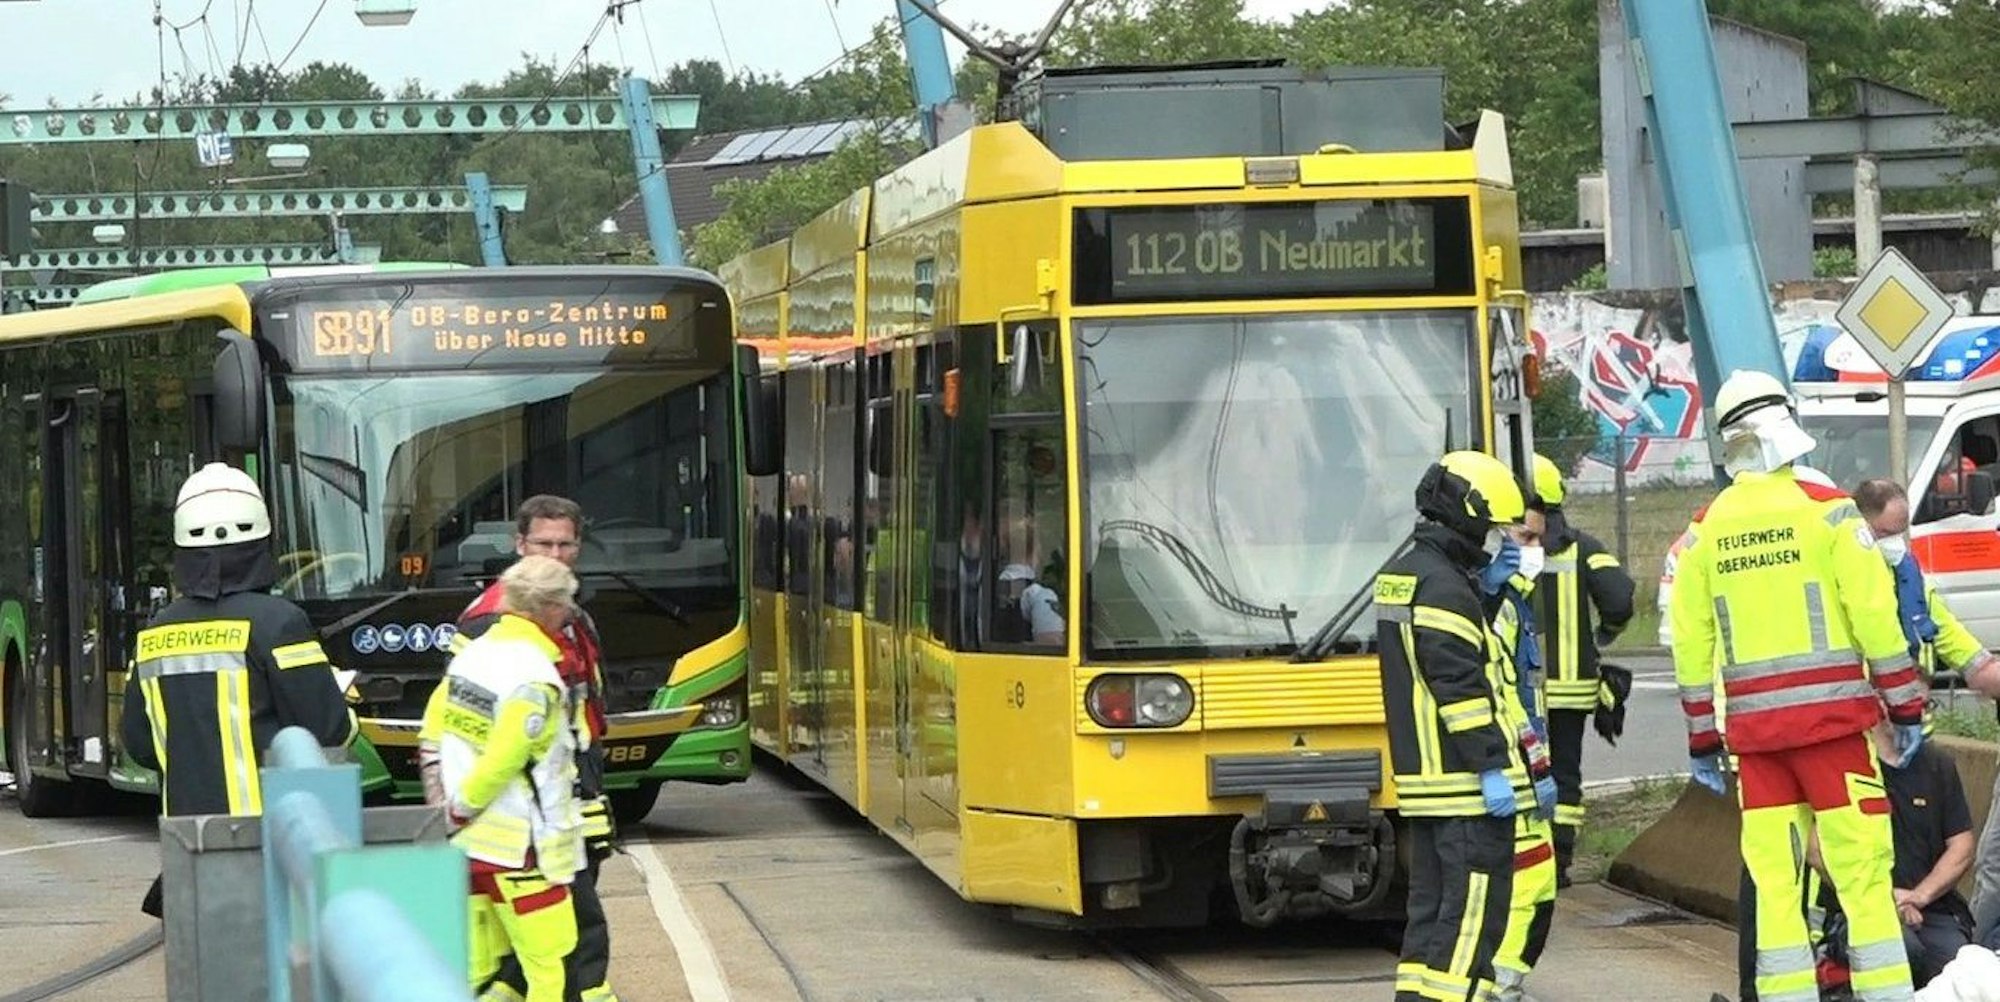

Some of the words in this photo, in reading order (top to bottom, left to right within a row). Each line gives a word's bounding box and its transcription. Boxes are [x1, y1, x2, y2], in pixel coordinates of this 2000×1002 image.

[1127, 232, 1187, 275] 112
[1195, 230, 1243, 273] OB
[1259, 225, 1426, 272] Neumarkt
[314, 309, 391, 356] SB91
[434, 330, 493, 350] über
[1717, 527, 1795, 551] FEUERWEHR
[402, 556, 423, 576] 09
[1716, 549, 1800, 575] OBERHAUSEN
[141, 628, 242, 652] FEUERWEHR
